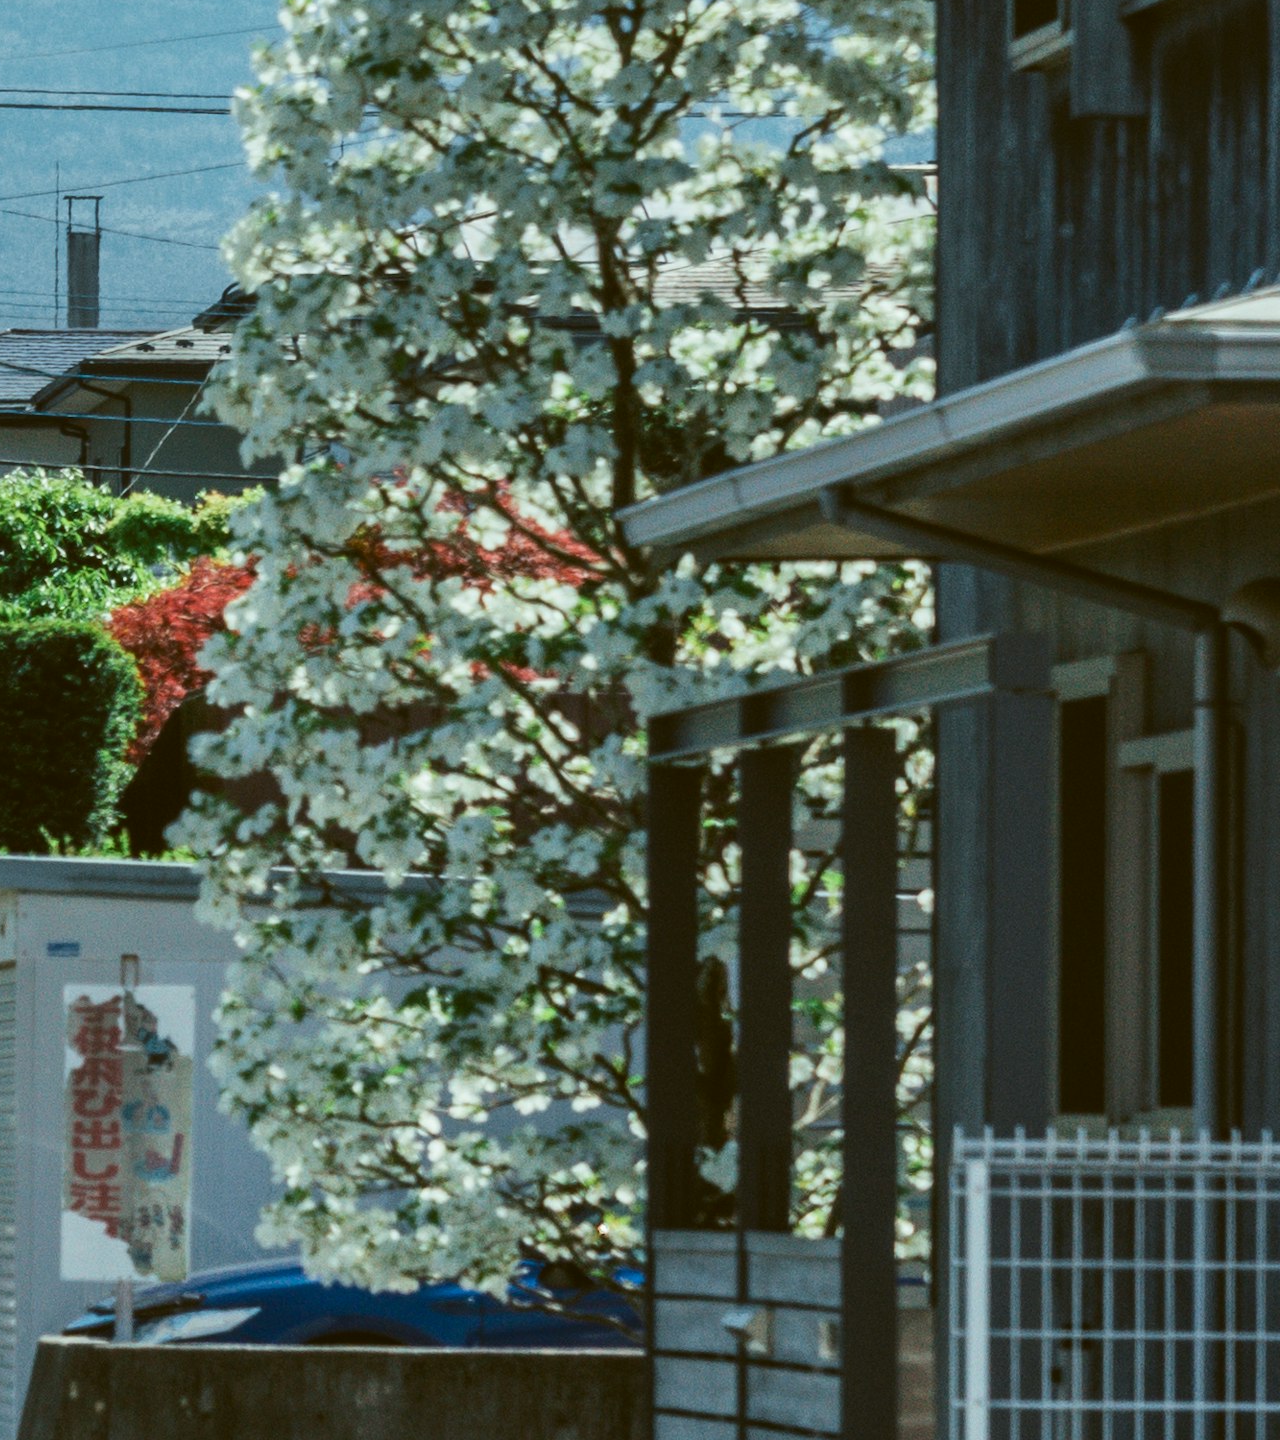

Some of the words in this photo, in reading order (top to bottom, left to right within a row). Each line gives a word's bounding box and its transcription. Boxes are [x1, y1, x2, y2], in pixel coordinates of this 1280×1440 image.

[70, 993, 123, 1238] 子供飛び出し注
